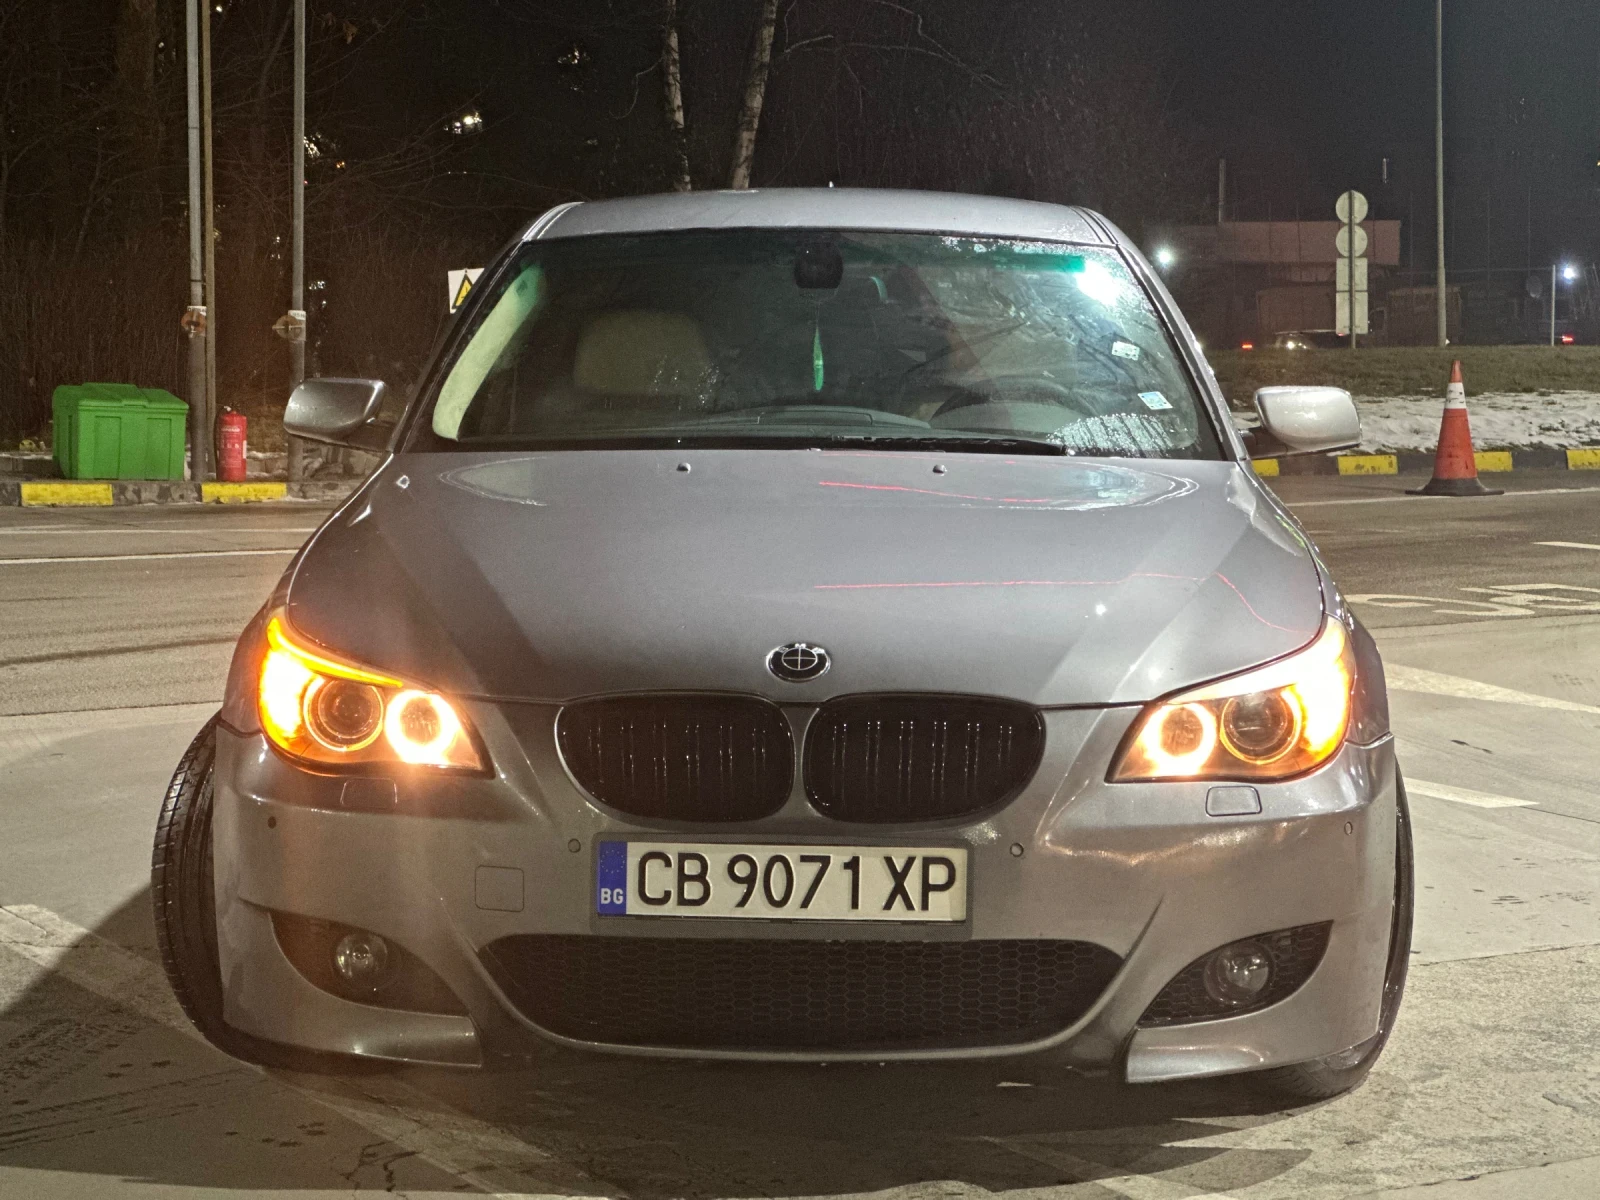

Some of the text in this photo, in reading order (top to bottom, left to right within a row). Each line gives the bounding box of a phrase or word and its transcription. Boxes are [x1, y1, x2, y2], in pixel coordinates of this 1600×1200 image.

[600, 888, 624, 905] BG
[638, 851, 956, 911] CB 9071 XP
